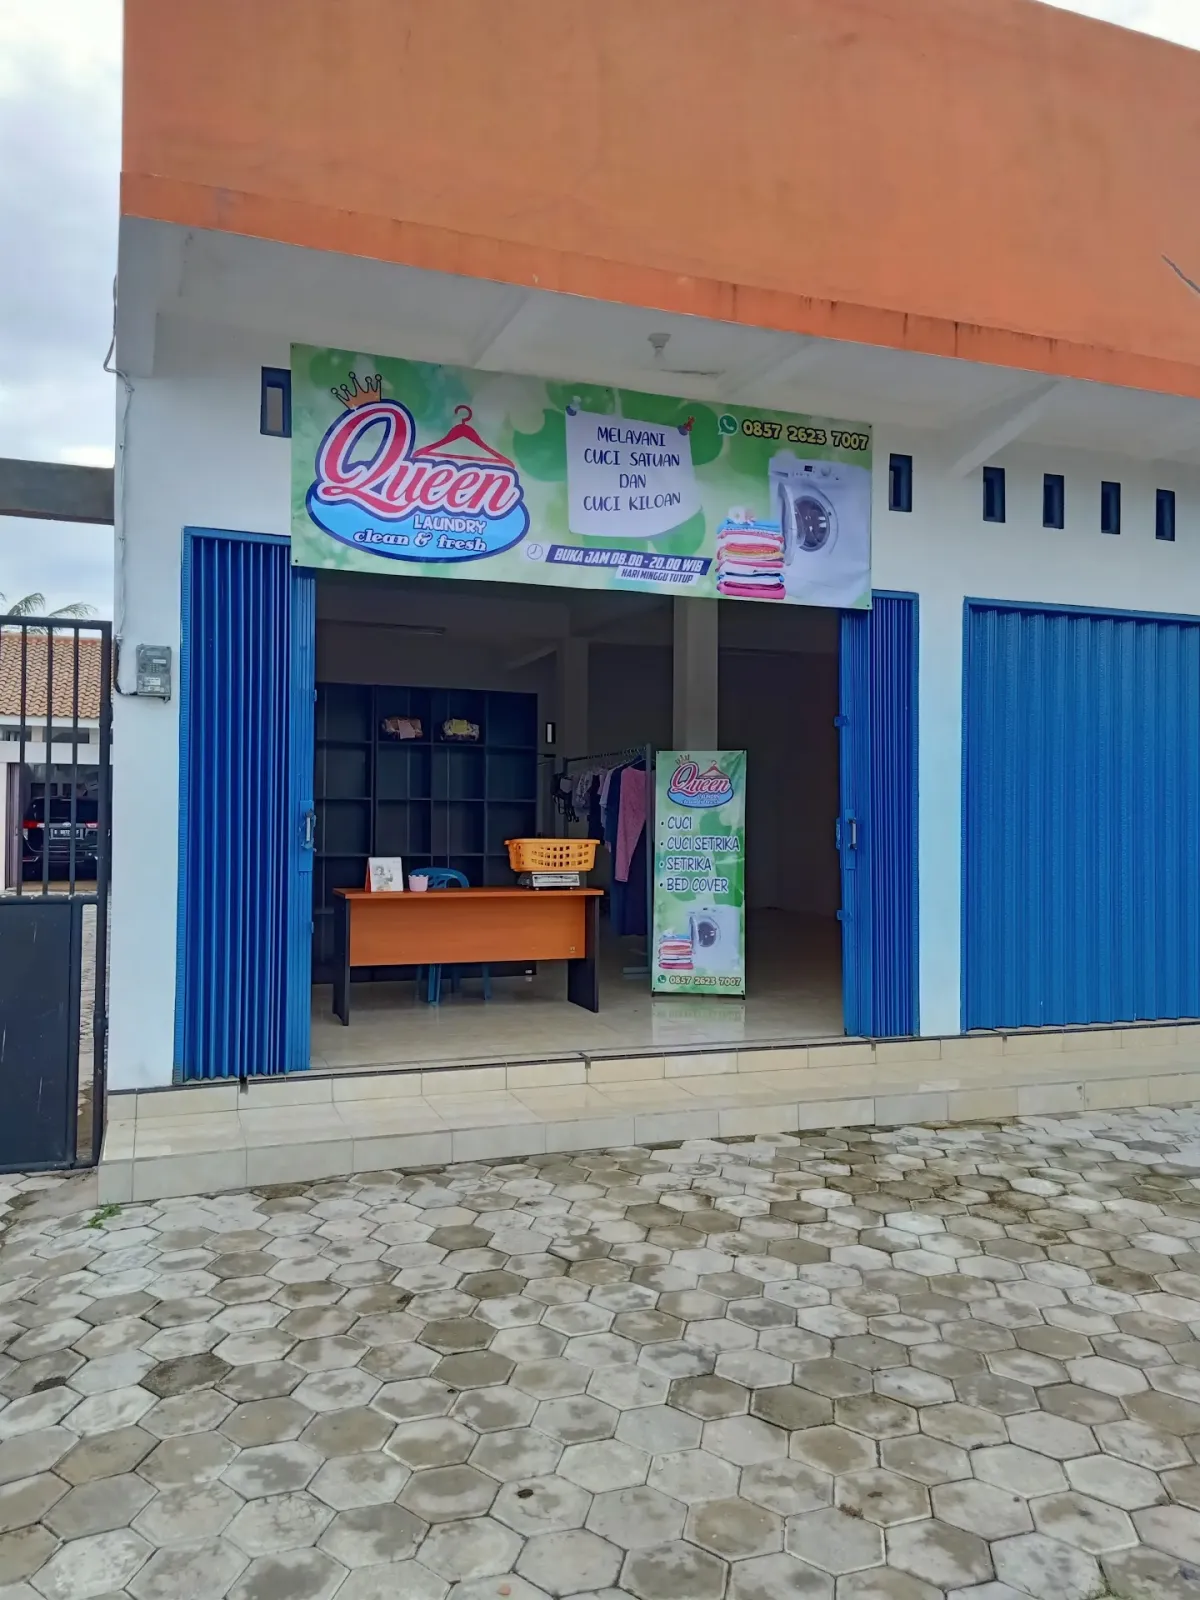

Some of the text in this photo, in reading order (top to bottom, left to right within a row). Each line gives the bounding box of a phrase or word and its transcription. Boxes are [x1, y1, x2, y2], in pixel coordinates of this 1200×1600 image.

[597, 426, 666, 447] MELAYANI
[742, 419, 869, 450] 0857 2623 7007
[318, 402, 521, 518] Queen
[584, 448, 680, 467] CUCI SATUAN
[619, 473, 647, 488] DAN
[583, 492, 681, 511] CUCI KILOAN
[413, 514, 487, 535] LAUNDRY
[353, 529, 487, 552] clean & fresh
[554, 548, 583, 561] BUKA
[584, 552, 609, 565] JAM
[610, 552, 644, 567] 08.00
[649, 557, 681, 571] 20.00
[682, 559, 704, 572] WIB
[621, 568, 693, 583] HARI MINGGU TUTUP
[671, 762, 731, 797] Queen
[667, 816, 692, 830] CUCI
[667, 836, 740, 851] CUCI SETRIKA
[666, 857, 712, 871] SETRIKA
[667, 877, 728, 892] BED COVER
[669, 975, 741, 986] 0857 2623 7007
